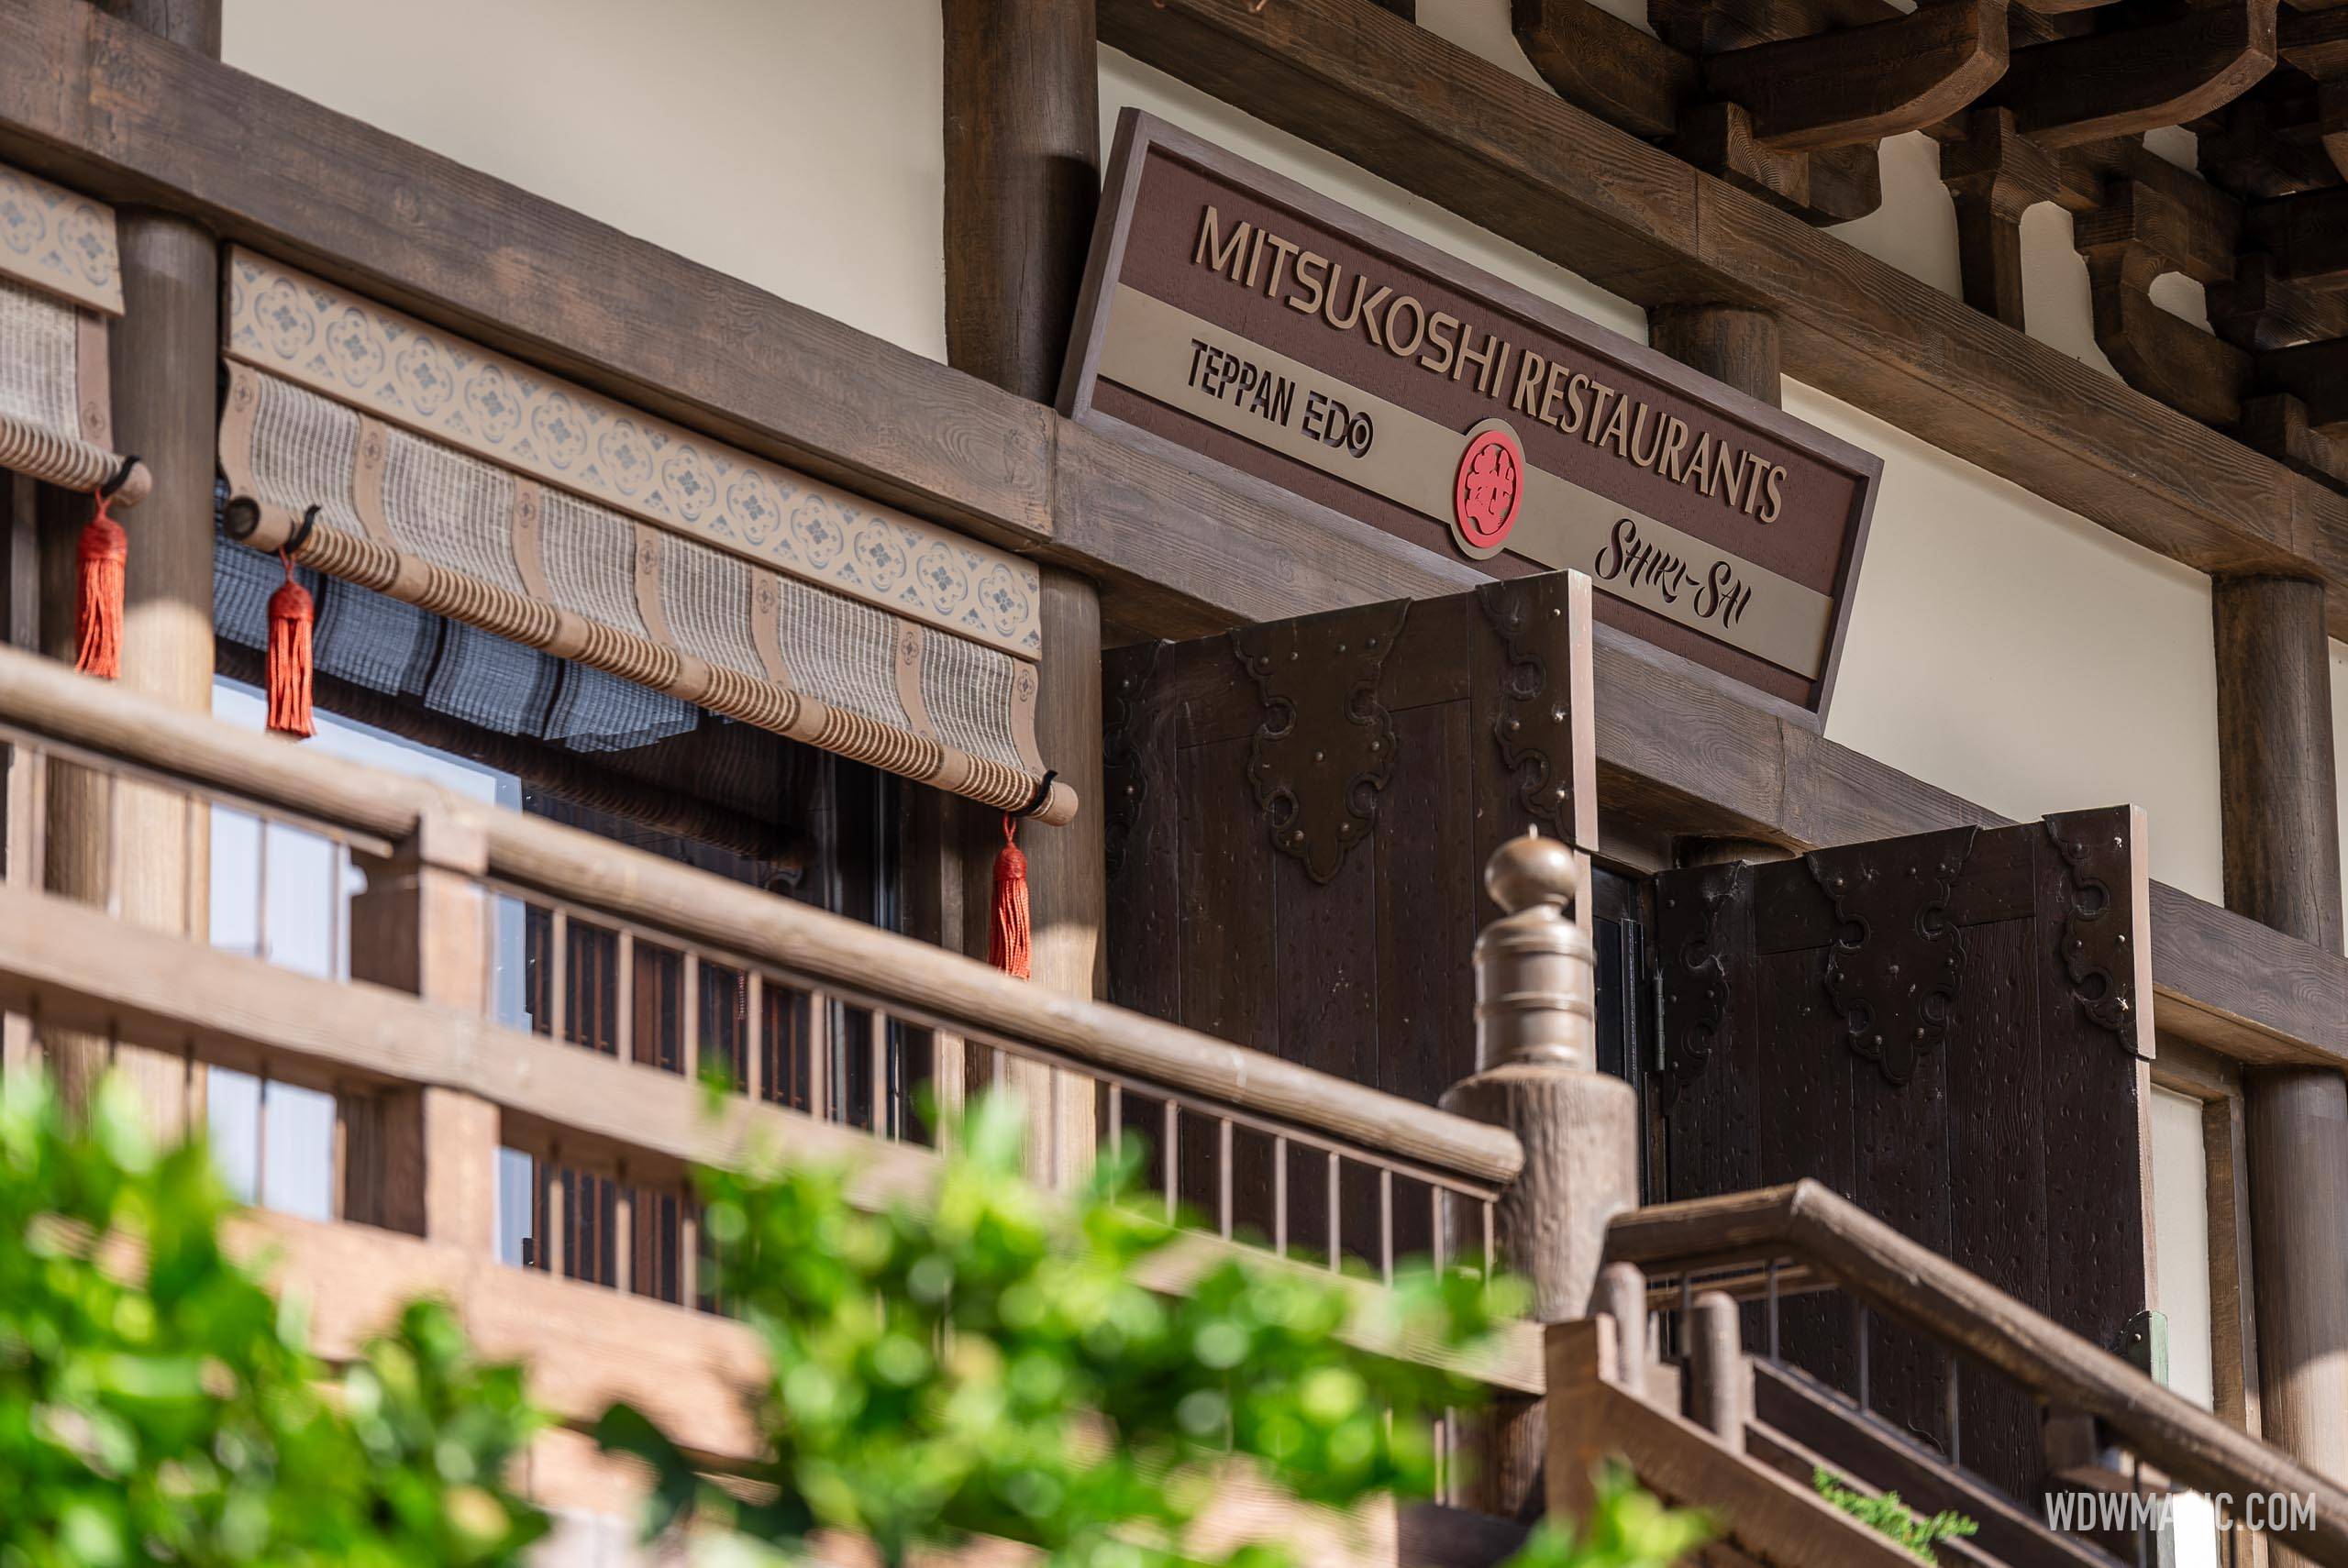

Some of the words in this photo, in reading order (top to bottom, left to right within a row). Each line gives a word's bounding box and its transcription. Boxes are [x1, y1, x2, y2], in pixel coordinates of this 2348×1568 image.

[1188, 337, 1296, 427] TEPPAN
[1301, 390, 1374, 458] EDO
[1195, 204, 1511, 398] MITSUKOSHI
[1512, 349, 1788, 524] RESTAURANTS
[1594, 518, 1752, 629] SHIKI-SAI
